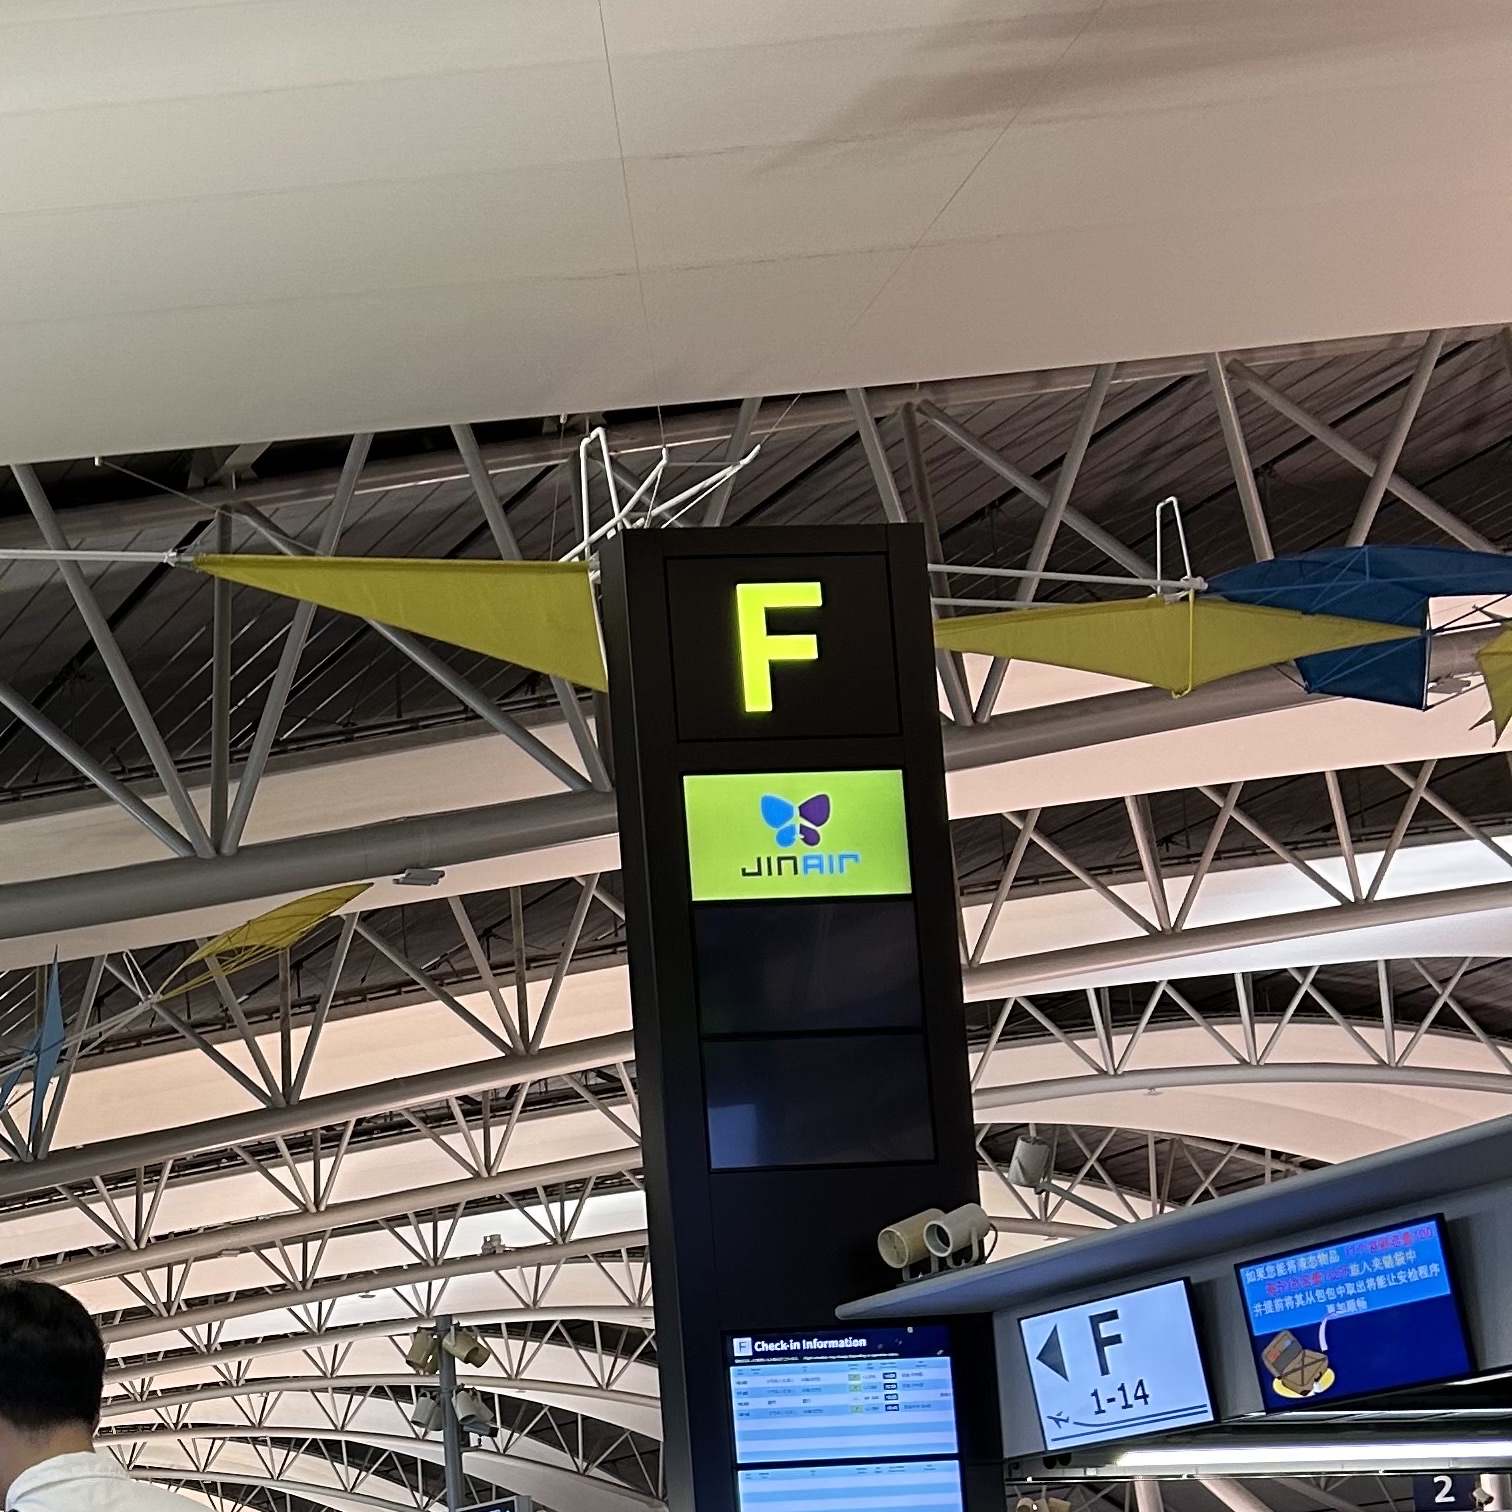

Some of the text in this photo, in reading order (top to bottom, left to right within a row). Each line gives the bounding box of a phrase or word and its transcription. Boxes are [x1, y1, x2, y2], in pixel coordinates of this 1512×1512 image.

[736, 582, 822, 712] F
[754, 1339, 800, 1352] Check-in
[803, 1337, 867, 1350] Information
[1089, 1310, 1123, 1376] F
[1090, 1379, 1149, 1415] 1-14
[1433, 1475, 1455, 1503] 2
